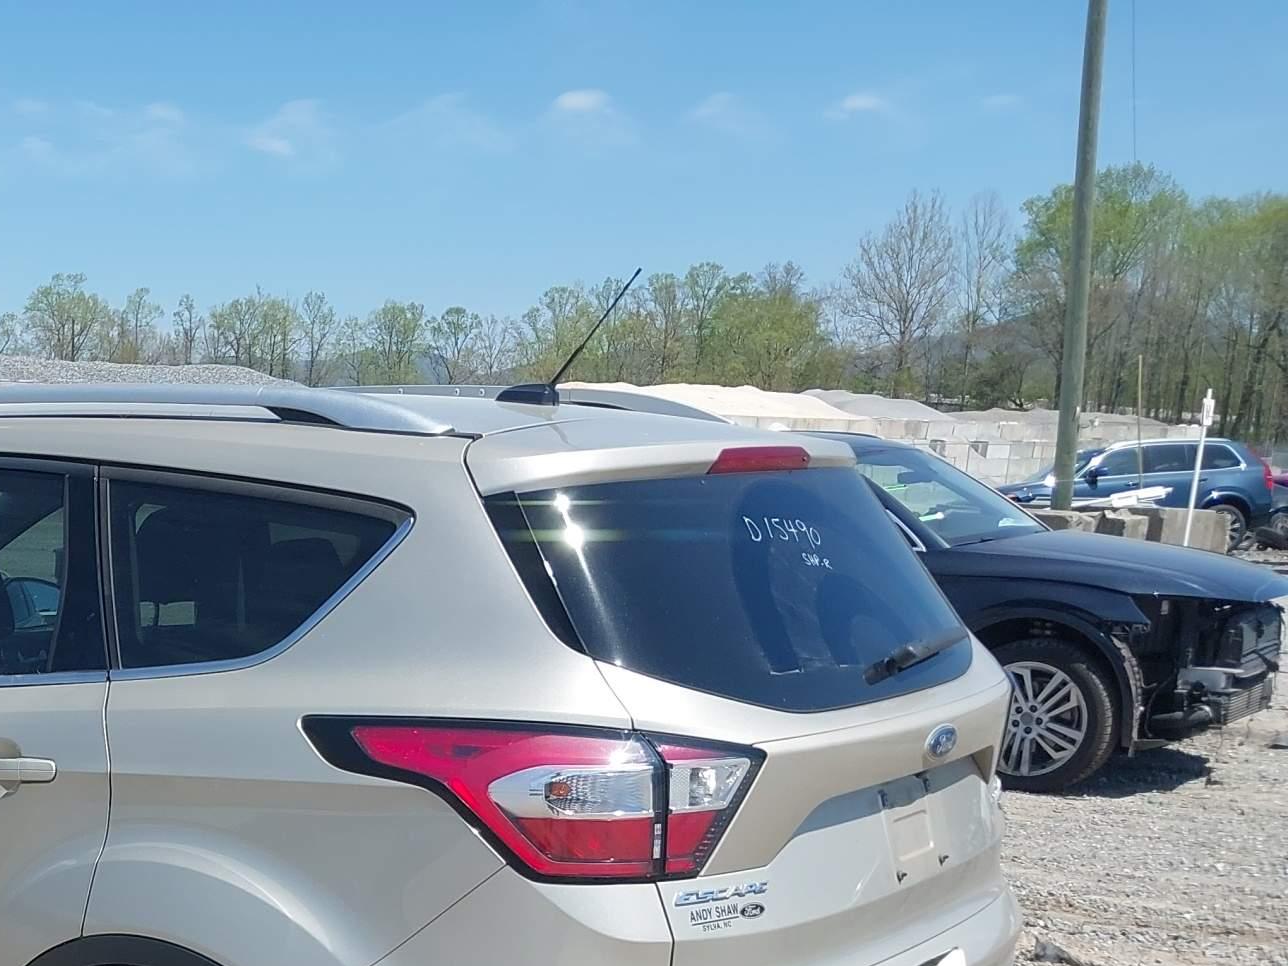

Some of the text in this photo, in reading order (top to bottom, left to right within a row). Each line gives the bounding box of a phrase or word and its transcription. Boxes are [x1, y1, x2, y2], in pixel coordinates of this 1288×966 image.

[742, 516, 821, 549] D15490
[674, 881, 768, 907] ESCAPE
[690, 909, 712, 923] ANDY
[715, 903, 739, 918] SHAW
